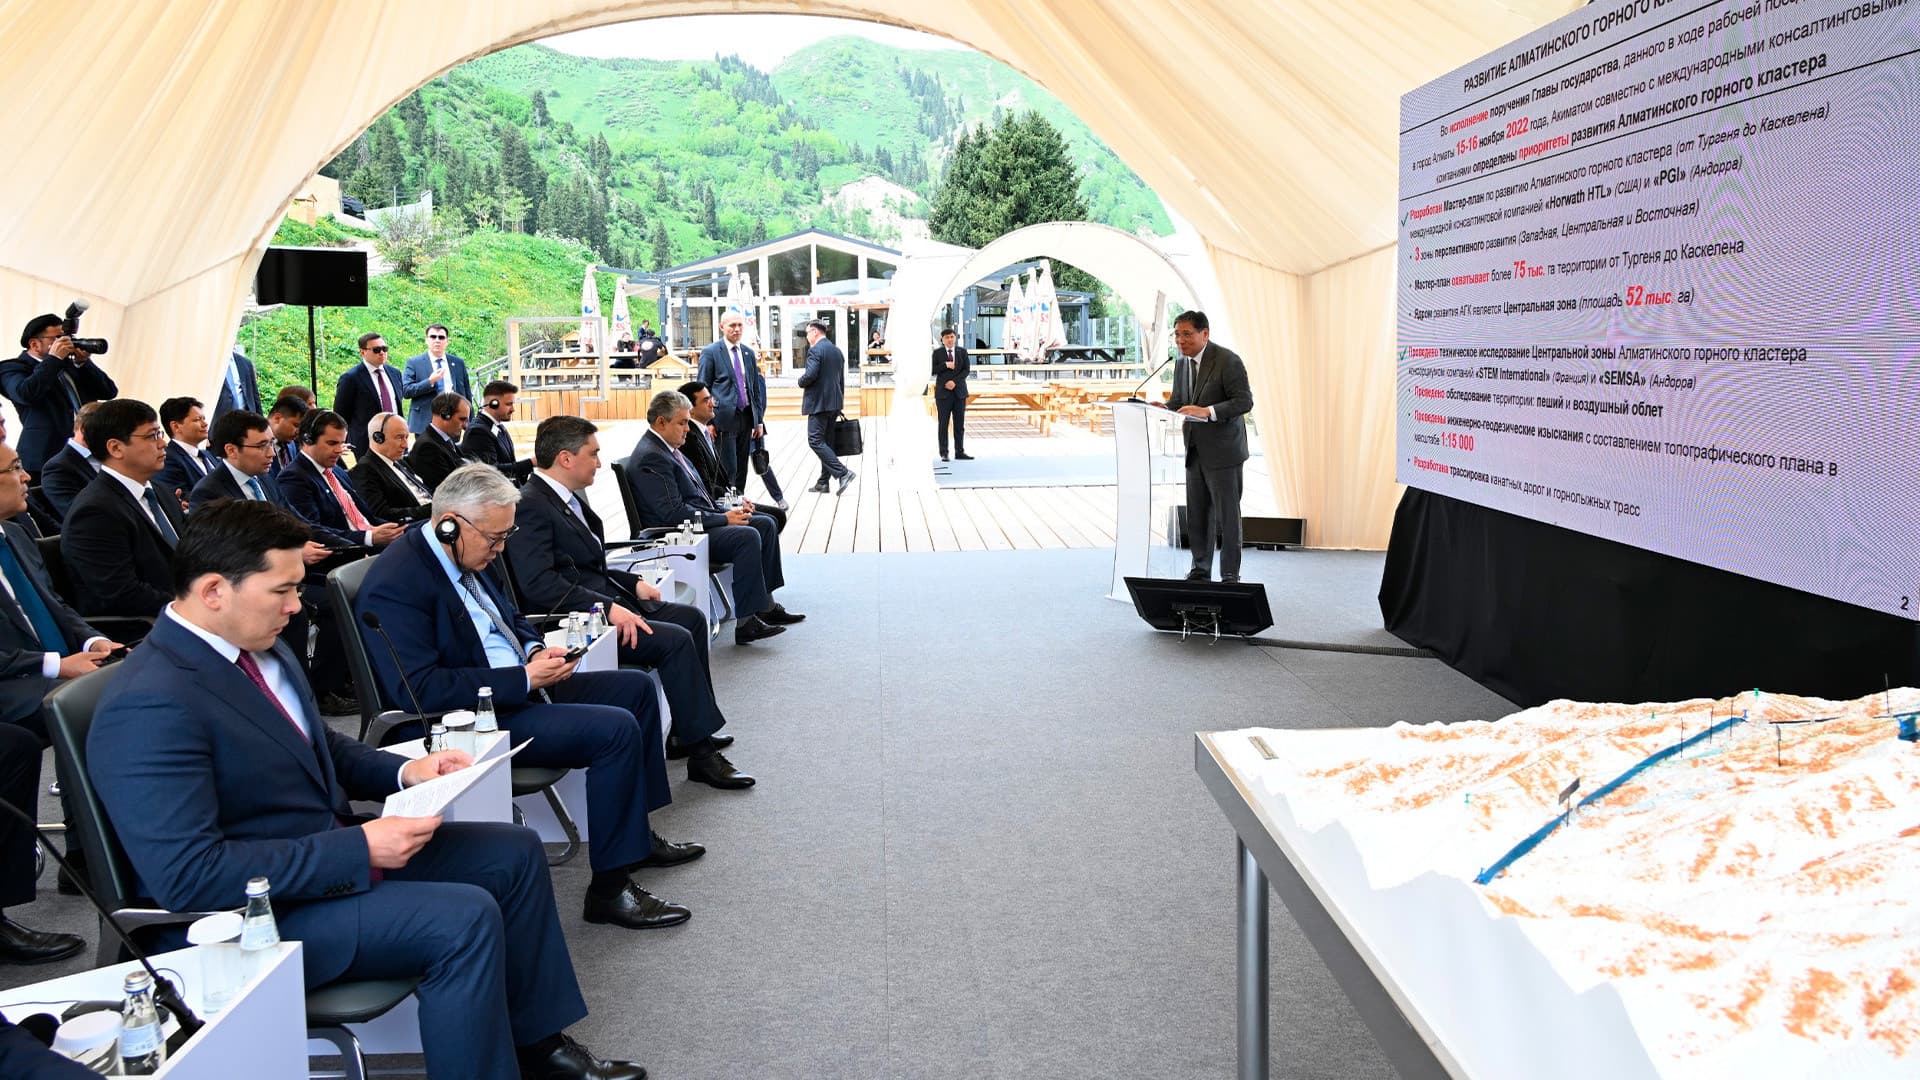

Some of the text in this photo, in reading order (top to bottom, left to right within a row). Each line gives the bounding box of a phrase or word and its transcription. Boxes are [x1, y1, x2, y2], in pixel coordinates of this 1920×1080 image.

[1450, 110, 1489, 133] исполнение
[1490, 94, 1530, 118] поручения
[1531, 84, 1558, 101] Главы
[1560, 59, 1620, 92] государства,
[1623, 41, 1665, 69] данного
[1668, 37, 1675, 50] в
[1677, 26, 1704, 46] ходе
[1708, 1, 1761, 38] рабочей
[1464, 0, 1649, 92] РАЗВИТИЕ АЛМАТИНСКОГО ГОРНОГО
[1433, 149, 1455, 164] Алматы
[1456, 136, 1478, 155] 15-16
[1479, 131, 1505, 148] ноября
[1506, 117, 1529, 139] 2022
[1530, 117, 1549, 131] года,
[1551, 100, 1592, 122] Акиматом
[1595, 82, 1645, 108] совместно
[1649, 78, 1655, 90] с
[1657, 40, 1764, 88] международными
[1473, 149, 1517, 173] определены
[1519, 134, 1569, 159] приоритеты
[1571, 120, 1615, 145] развития
[1618, 94, 1697, 129] Алматинского
[1701, 77, 1753, 103] горного
[1757, 53, 1827, 87] кластера
[1443, 192, 1484, 212] Мастер-план
[1495, 182, 1528, 200] развитию
[1530, 167, 1586, 190] Алматинского
[1588, 156, 1622, 178] горного
[1626, 144, 1672, 165] кластера
[1676, 140, 1694, 158] (от
[1698, 126, 1739, 151] Тургеня
[1743, 121, 1756, 136] до
[1760, 102, 1829, 133] Каскелена)
[1503, 200, 1543, 221] компанией
[1545, 189, 1585, 209] «Horwath
[1587, 184, 1612, 201] HTL»
[1614, 178, 1641, 198] (США)
[1644, 178, 1650, 188] и
[1653, 168, 1686, 186] «PGI»
[1690, 156, 1742, 181] (Андорра)
[1415, 247, 1420, 261] 3
[1435, 241, 1484, 259] перспективного
[1486, 235, 1516, 251] развития
[1519, 225, 1558, 247] (Западная,
[1562, 214, 1624, 237] Центральная
[1626, 215, 1632, 225] и
[1635, 199, 1699, 224] Восточная)
[1415, 278, 1450, 291] Мастер-план
[1491, 269, 1512, 281] более
[1513, 260, 1526, 279] 75
[1527, 266, 1545, 278] тыс.
[1548, 262, 1555, 271] га
[1557, 259, 1607, 274] территории
[1609, 256, 1620, 268] от
[1623, 250, 1661, 267] Тургеня
[1664, 249, 1678, 263] до
[1681, 240, 1744, 259] Каскелена
[1503, 299, 1554, 314] Центральная
[1556, 298, 1577, 311] зона
[1579, 293, 1623, 312] (площадь
[1626, 285, 1644, 306] 52
[1678, 287, 1695, 303] га)
[1440, 347, 1477, 358] техническое
[1479, 347, 1530, 360] исследование
[1532, 345, 1588, 361] Центральной
[1590, 346, 1615, 360] зоны
[1618, 345, 1690, 360] Алматинского
[1694, 347, 1739, 363] горного
[1743, 346, 1807, 364] кластера
[1475, 366, 1498, 380] «STEM
[1590, 373, 1596, 382] и
[1599, 371, 1646, 386] «SEMSA»
[1650, 374, 1696, 391] (Андорра)
[1446, 388, 1491, 403] обследование
[1537, 395, 1564, 409] пеший
[1566, 400, 1571, 410] и
[1573, 399, 1629, 416] воздушный
[1632, 404, 1663, 418] облет
[1447, 417, 1535, 436] инженерно-геодезические
[1537, 426, 1583, 442] изыскания
[1586, 433, 1591, 443] с
[1593, 434, 1661, 453] составлением
[1664, 441, 1775, 468] топографического
[1779, 455, 1824, 475] плана
[1829, 462, 1837, 476] в
[1459, 434, 1474, 451] 000
[1450, 466, 1489, 483] трассировка
[1524, 481, 1545, 495] дорог
[1547, 488, 1552, 497] и
[1553, 487, 1611, 511] горнолыжных
[1614, 500, 1641, 517] трасс
[1900, 596, 1909, 610] 2
